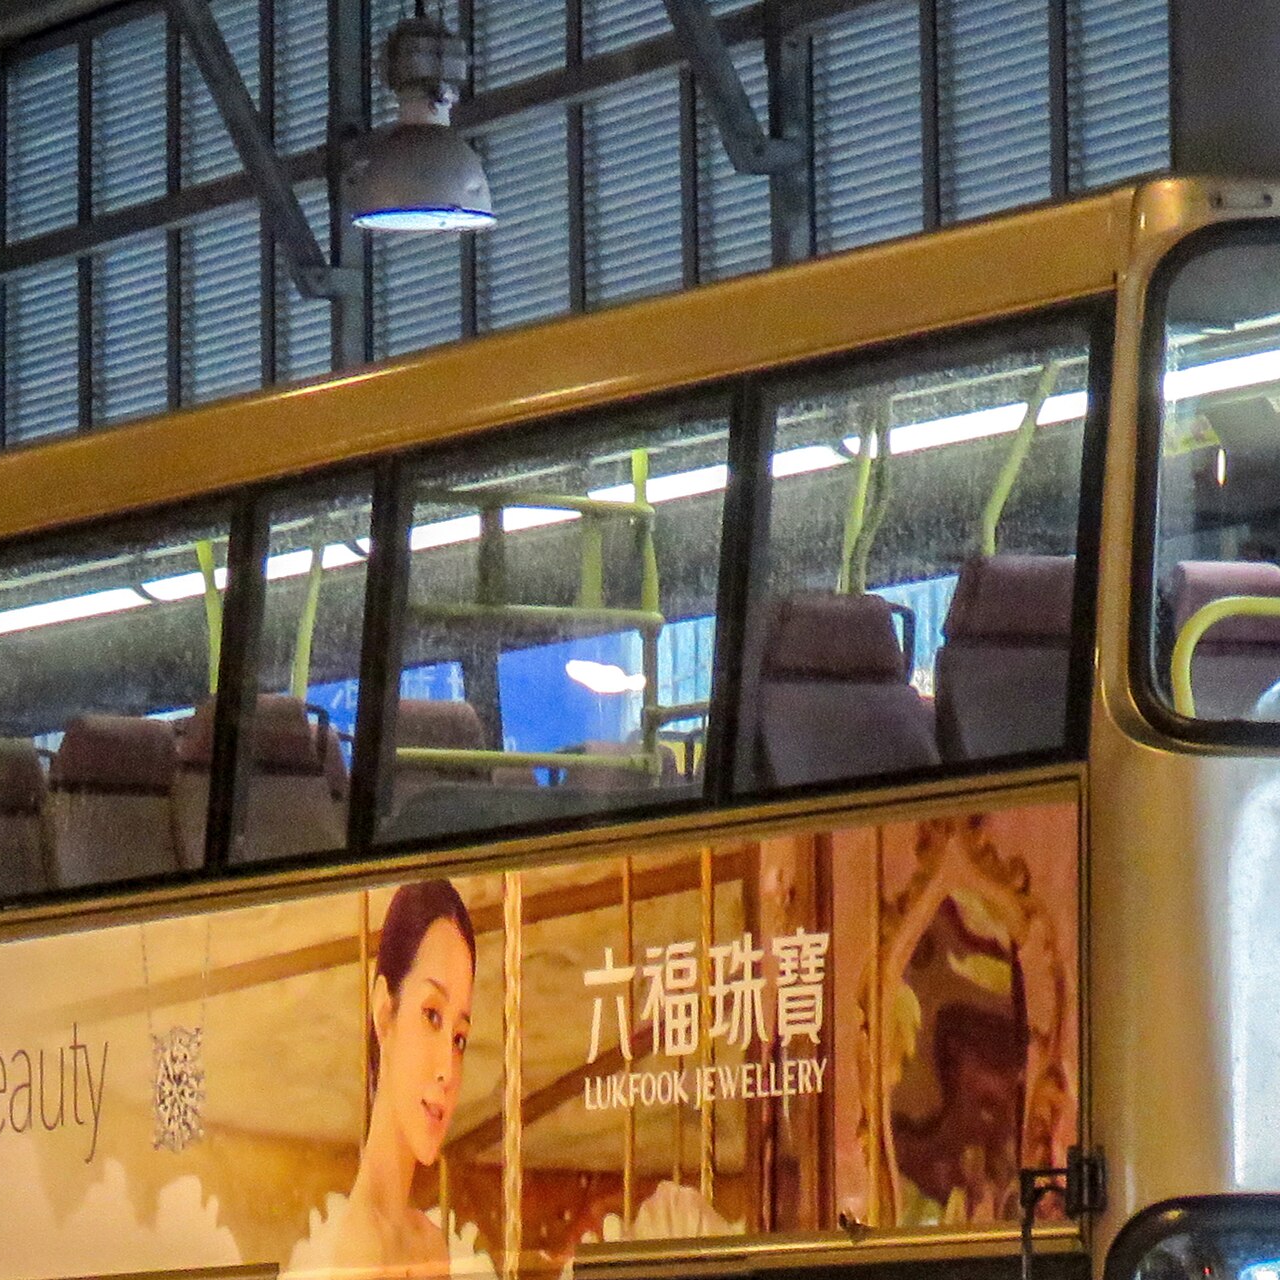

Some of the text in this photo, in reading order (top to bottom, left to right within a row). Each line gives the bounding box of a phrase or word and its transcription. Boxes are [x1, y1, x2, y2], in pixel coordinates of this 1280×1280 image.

[583, 926, 831, 1065] 六福珠寶
[583, 1056, 829, 1112] LUKFOOK JEWELLERY
